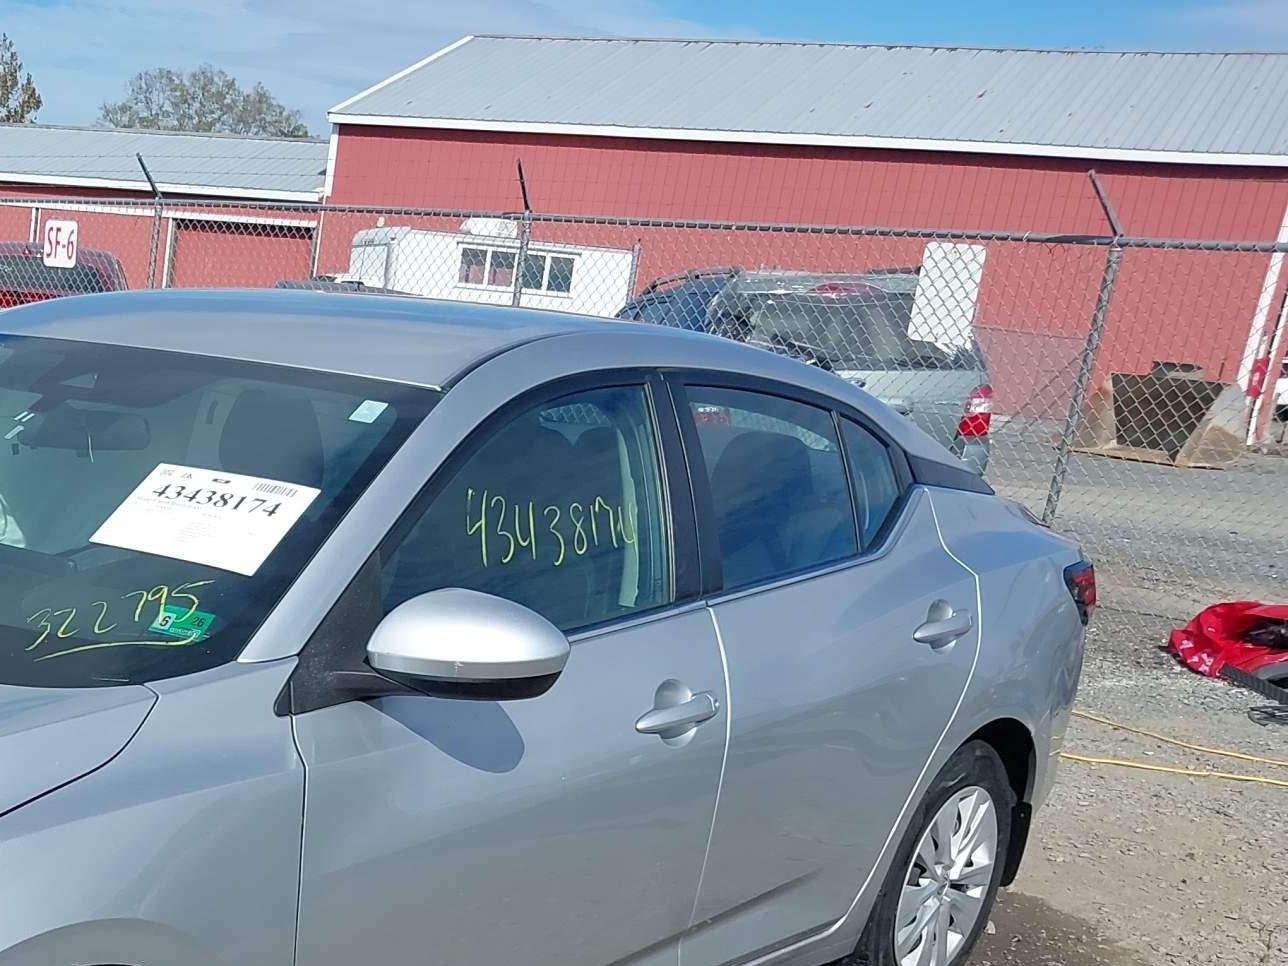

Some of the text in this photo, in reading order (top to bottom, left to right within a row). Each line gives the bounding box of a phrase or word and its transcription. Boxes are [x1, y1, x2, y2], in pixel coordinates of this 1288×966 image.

[44, 226, 74, 258] SF-6
[152, 483, 282, 517] 43438174
[466, 487, 638, 568] 43438174
[191, 616, 206, 628] 26
